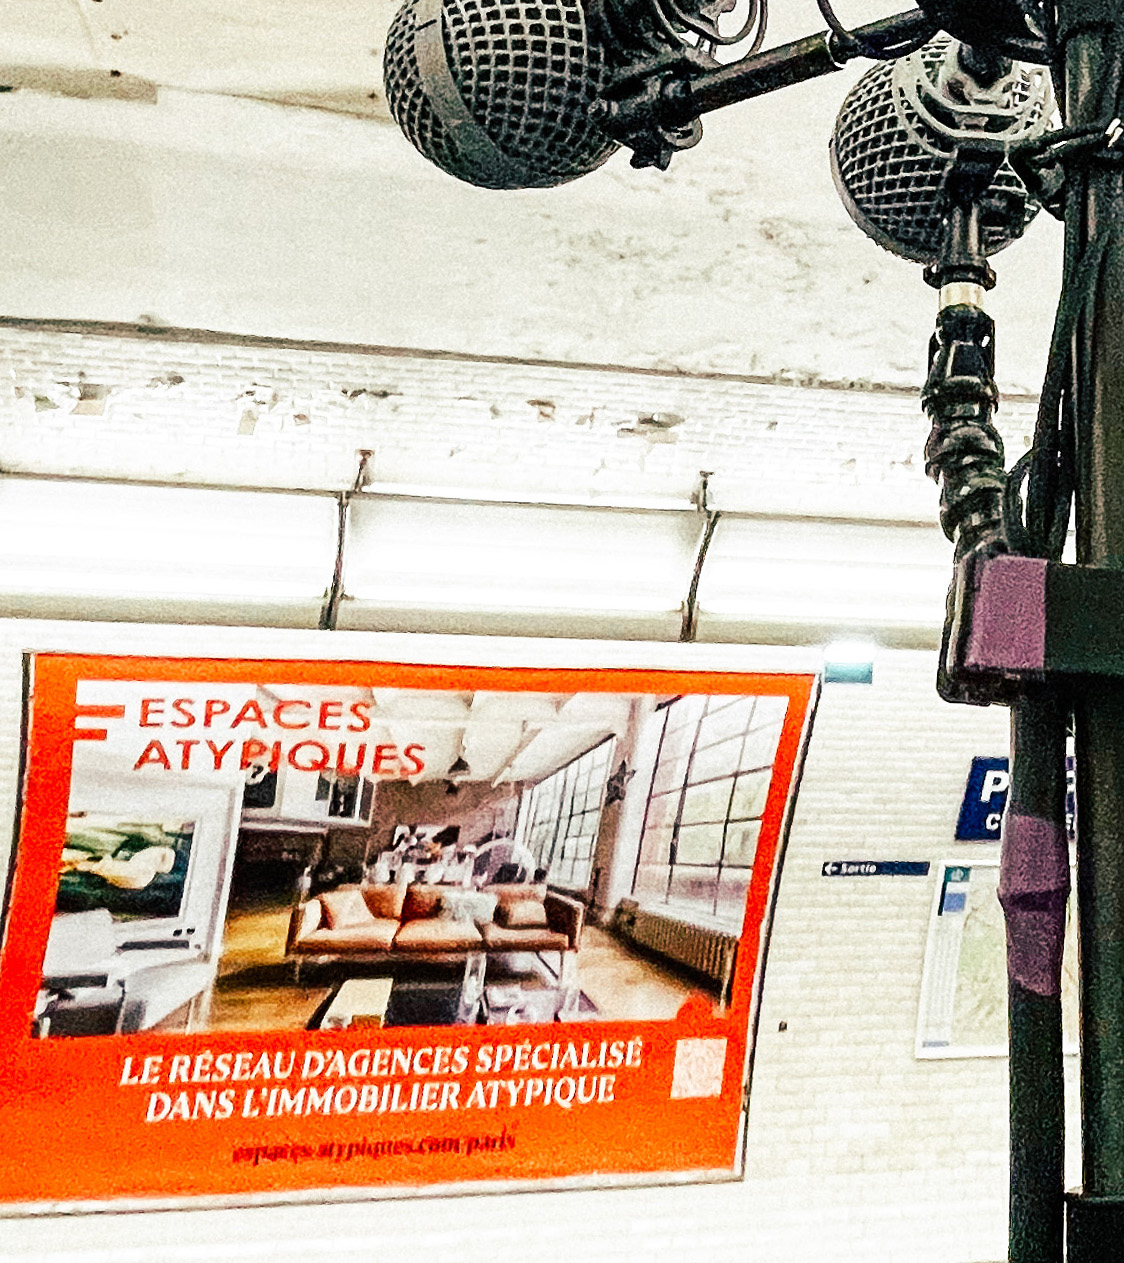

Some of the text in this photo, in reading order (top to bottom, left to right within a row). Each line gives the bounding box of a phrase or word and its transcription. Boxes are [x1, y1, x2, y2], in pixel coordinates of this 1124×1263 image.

[138, 698, 372, 732] ESPACES
[133, 739, 426, 775] ATYPIQUES
[841, 862, 877, 875] Sortie
[119, 1036, 643, 1086] LE RÉSEAU D'AGENCES SPÉCIALISÉ
[145, 1074, 616, 1123] DANS L'IMMOBILIER ATYPIQUE
